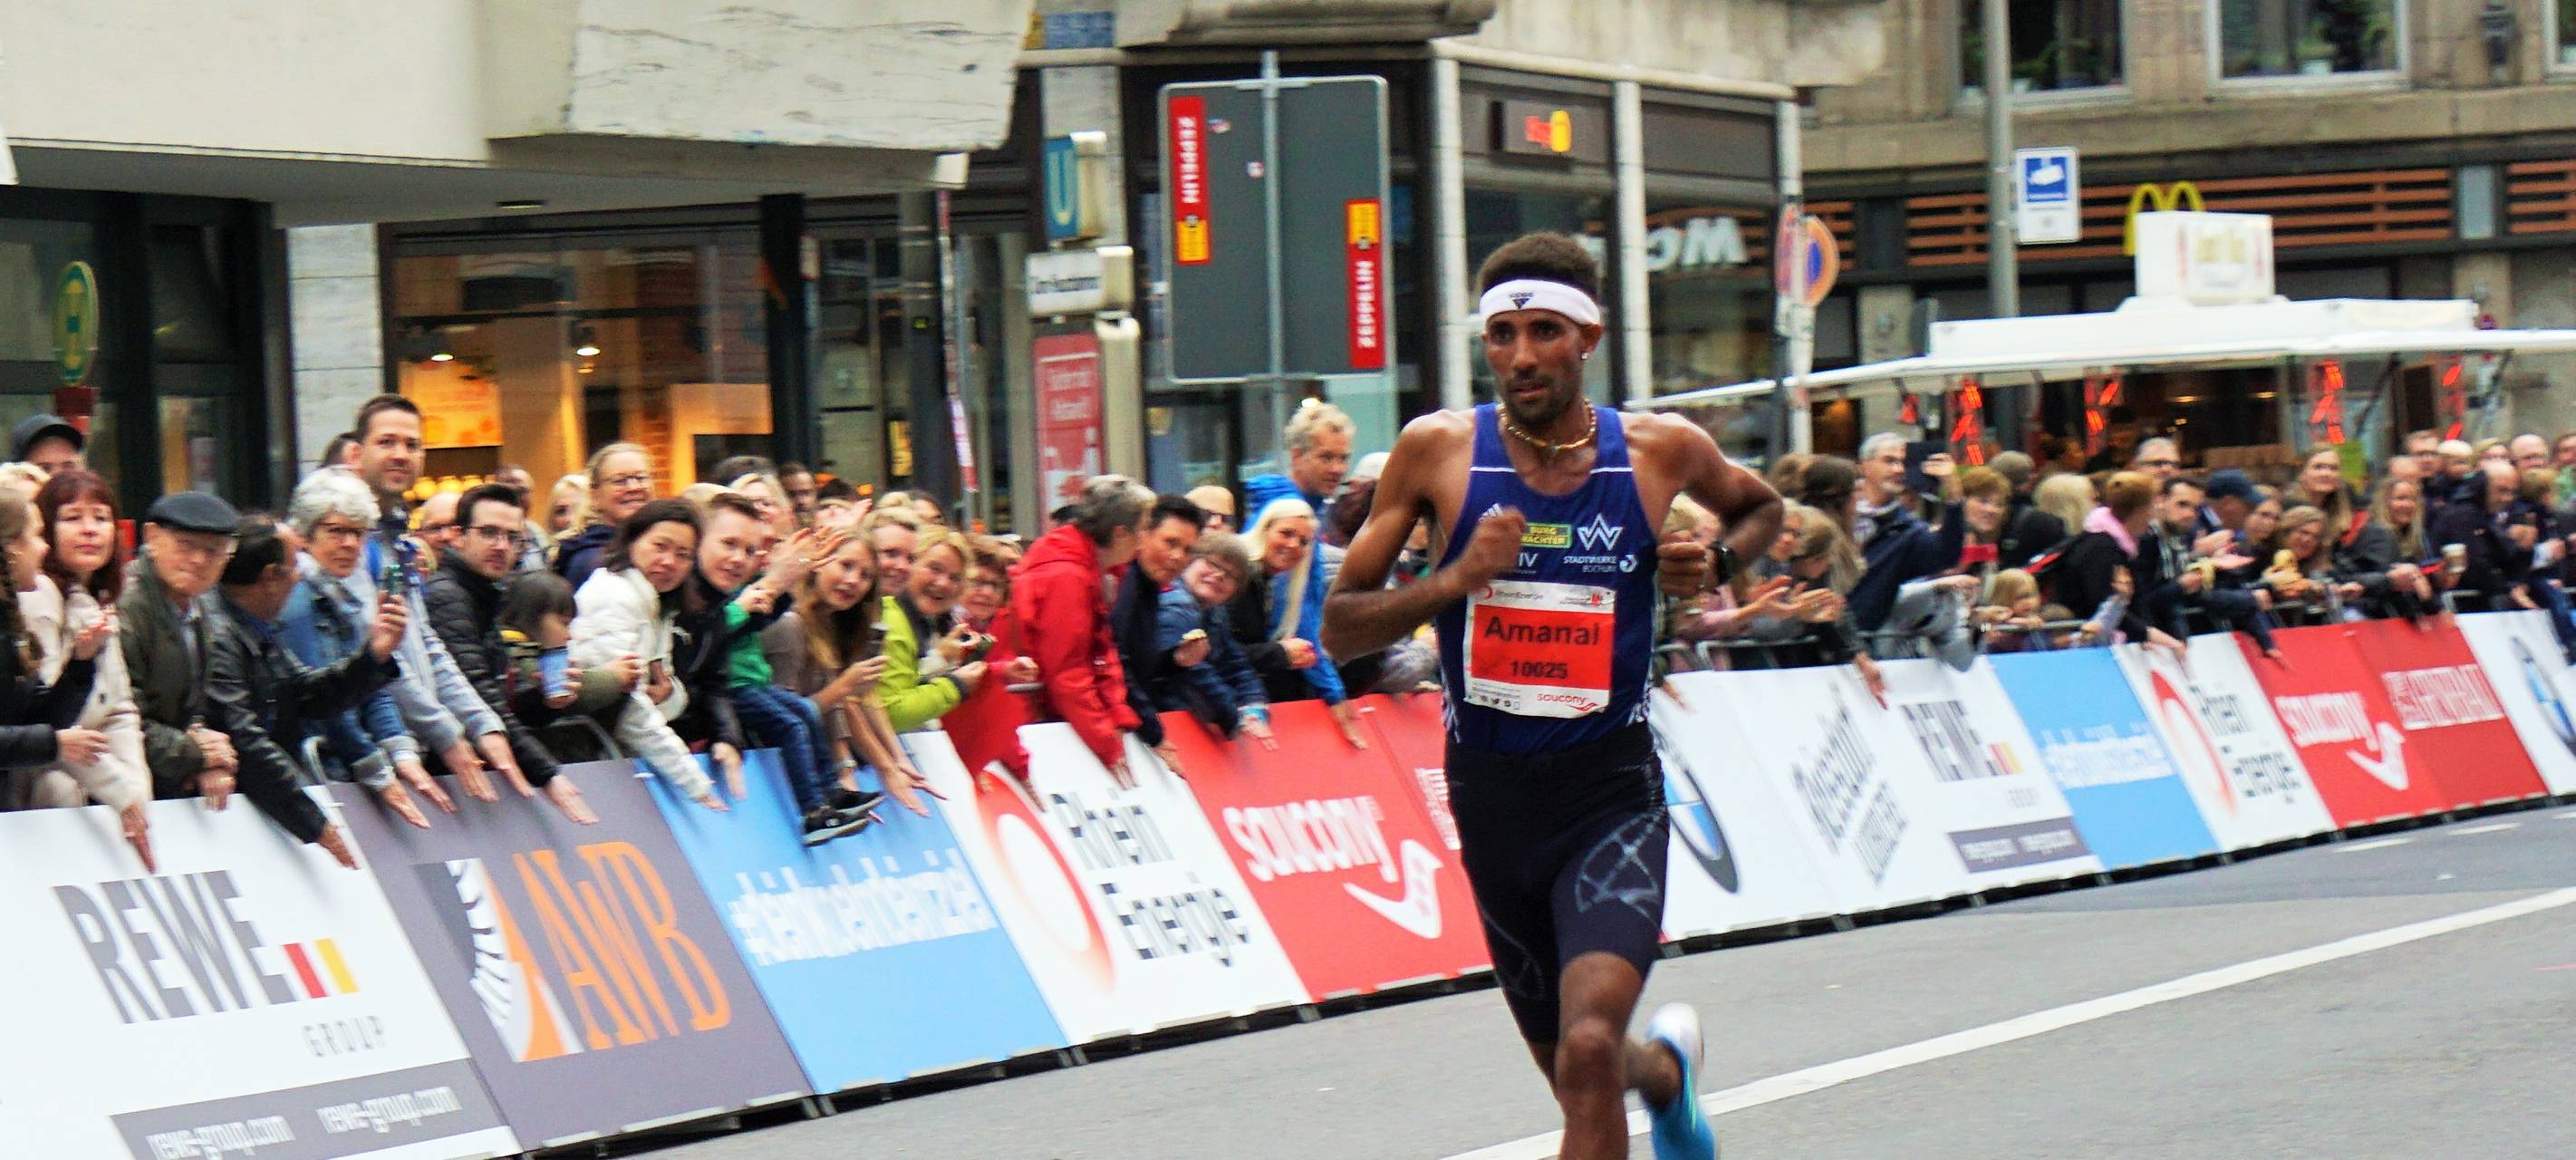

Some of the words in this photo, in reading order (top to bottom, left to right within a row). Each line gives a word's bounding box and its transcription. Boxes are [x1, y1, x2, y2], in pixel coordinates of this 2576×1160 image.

[1047, 148, 1077, 227] U
[1177, 116, 1201, 203] ZEPPELIN
[1356, 260, 1376, 348] ZEPPELIN
[1510, 661, 1568, 680] 10025
[1537, 693, 1587, 705] saucony
[2274, 691, 2379, 752] saucony
[1049, 787, 1175, 871] Rhein
[1222, 795, 1400, 884] saucony
[53, 870, 301, 1024] REWE
[512, 841, 730, 1051] AWB
[1098, 871, 1252, 968] Energie
[303, 1015, 386, 1058] GROUP
